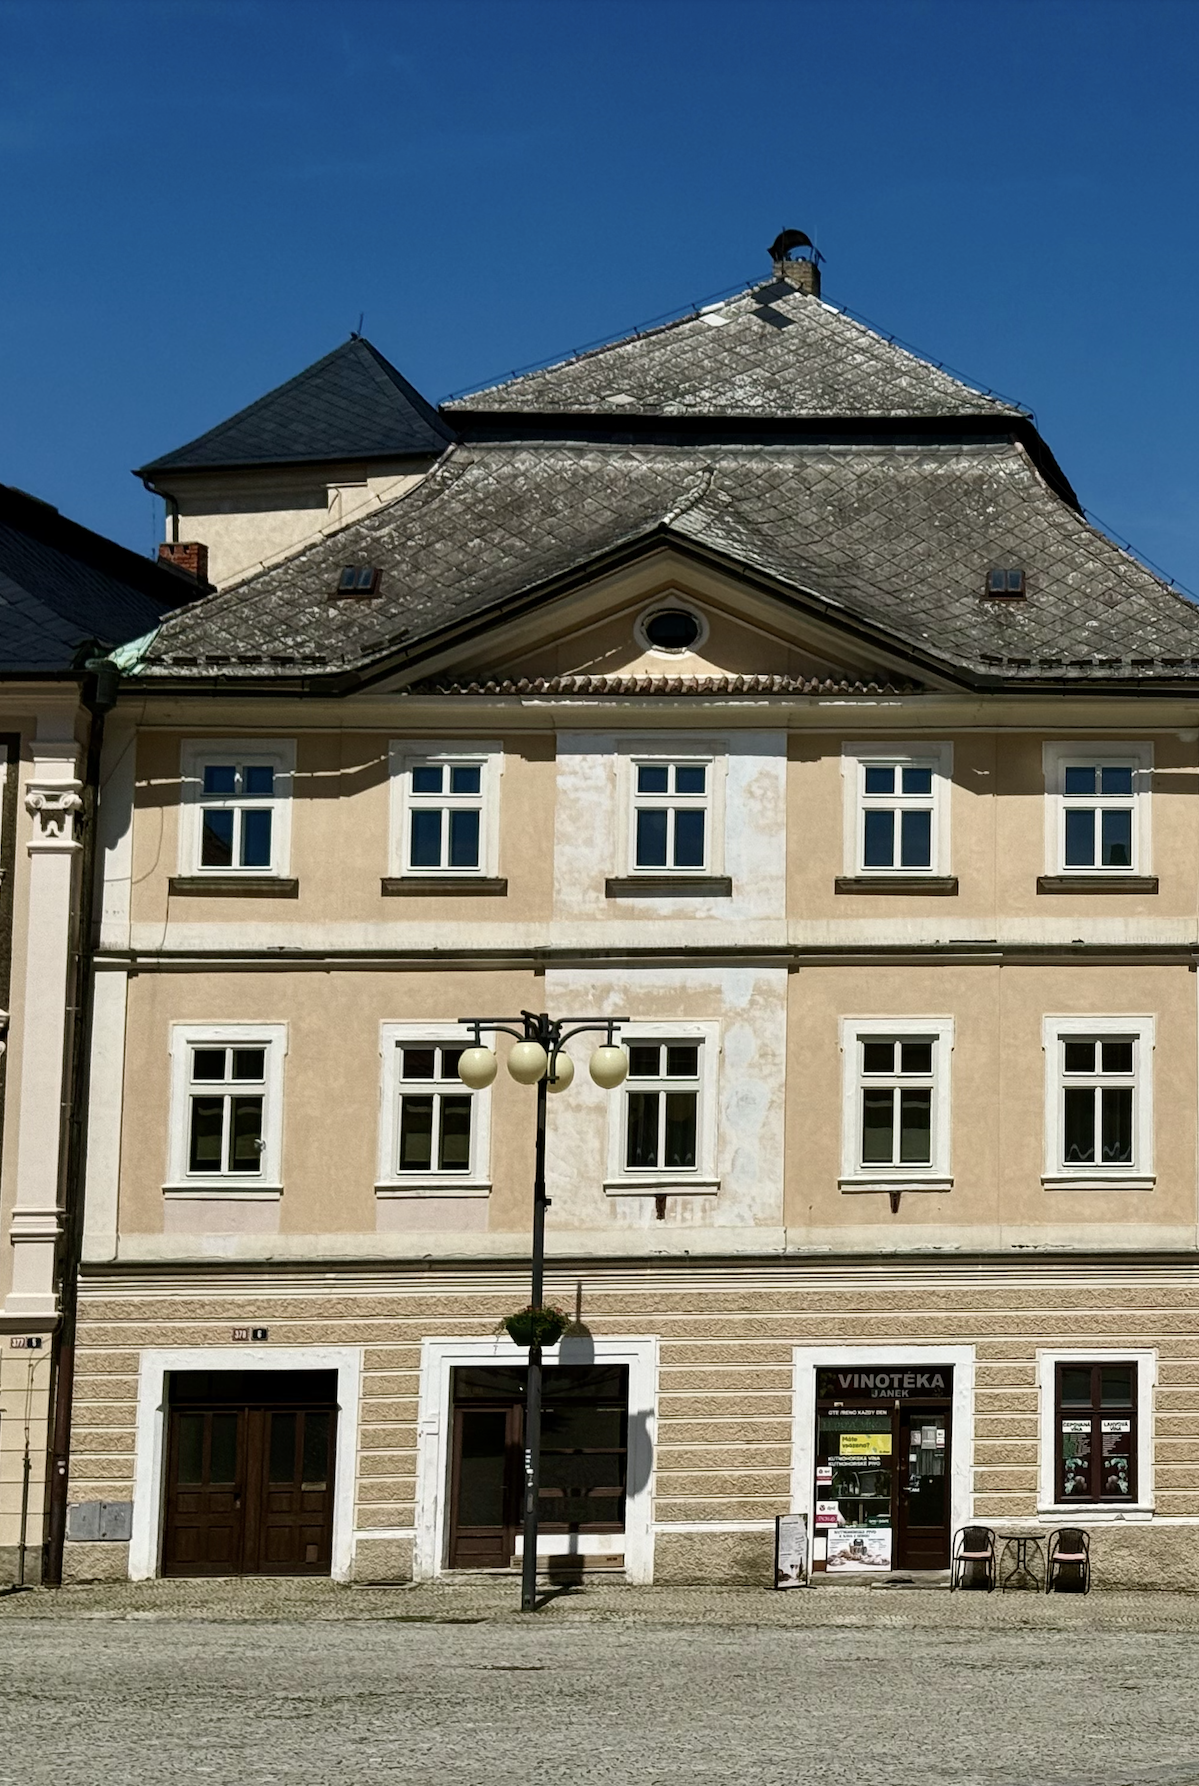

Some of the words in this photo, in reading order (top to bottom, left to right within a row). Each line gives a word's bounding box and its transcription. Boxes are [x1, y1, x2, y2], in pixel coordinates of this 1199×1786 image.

[12, 1338, 24, 1348] 377
[838, 1371, 945, 1389] VINOTÉKA
[871, 1389, 910, 1398] JANEK
